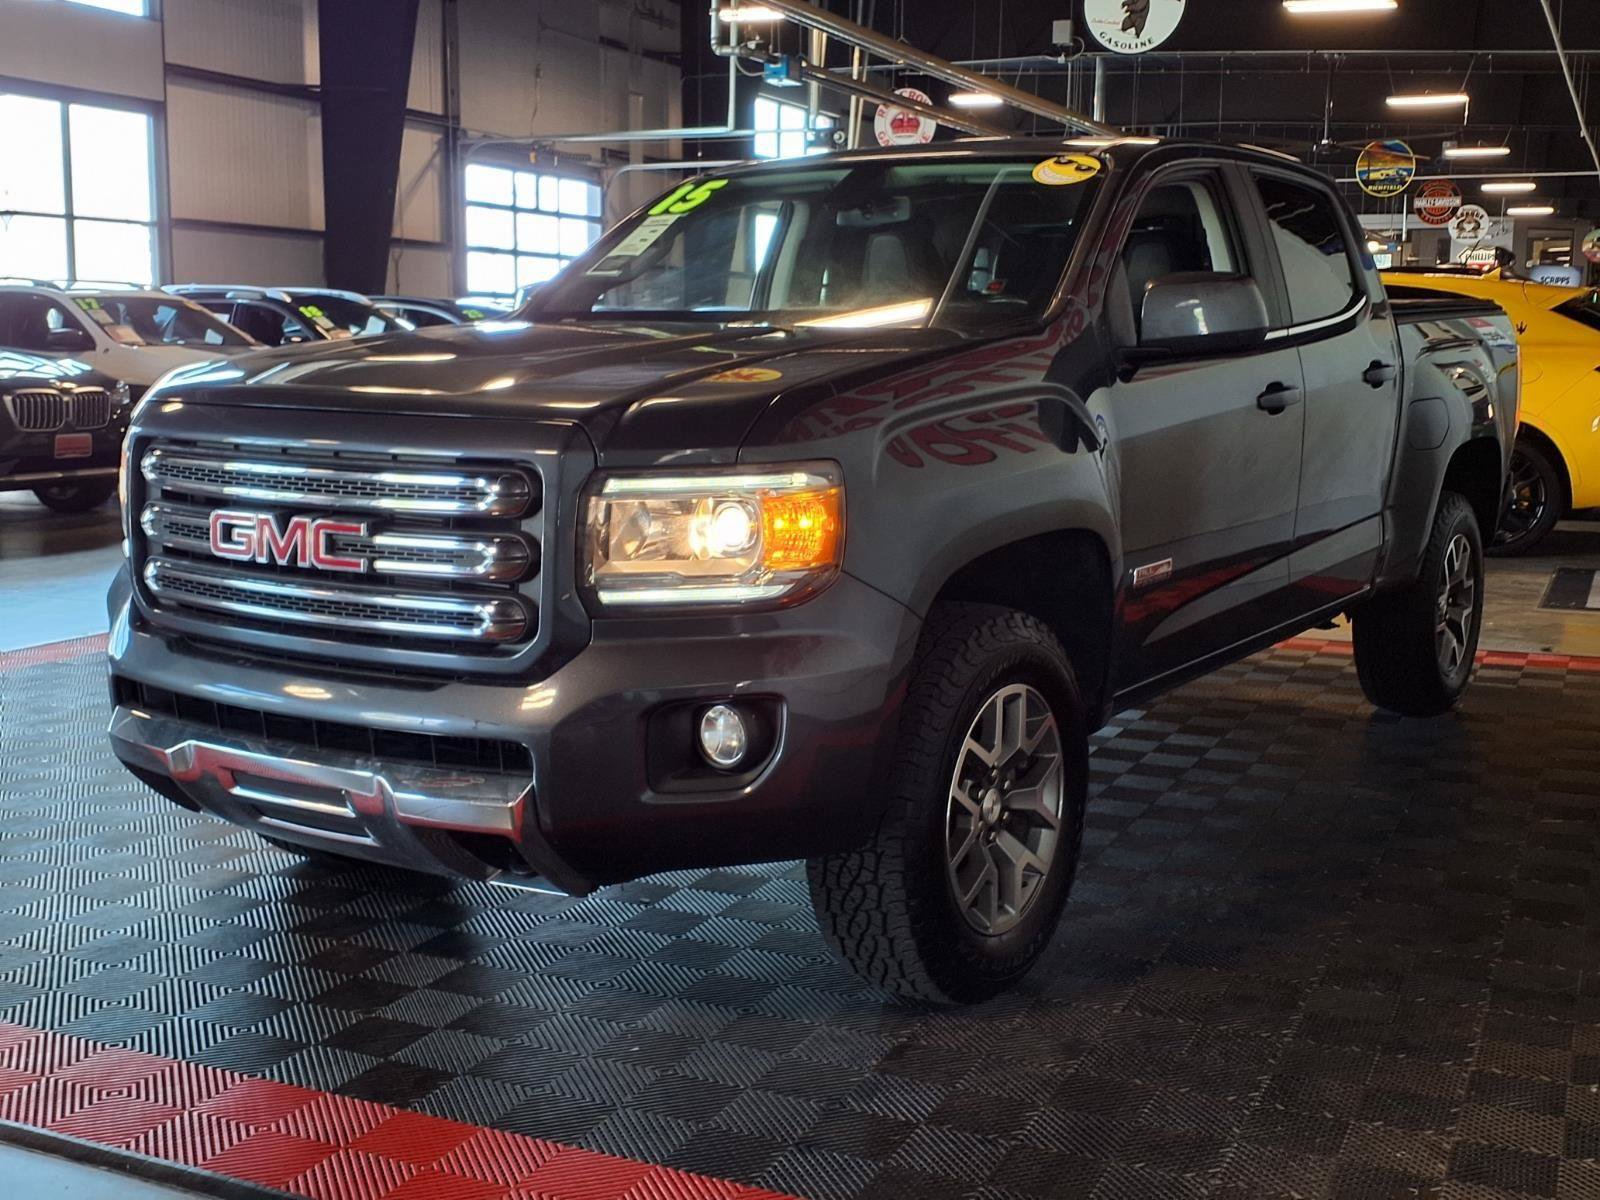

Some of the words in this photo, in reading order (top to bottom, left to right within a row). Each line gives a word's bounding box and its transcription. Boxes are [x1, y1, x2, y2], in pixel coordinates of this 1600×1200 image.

[1099, 31, 1155, 50] GASOLINE
[648, 178, 729, 216] 15
[1540, 275, 1571, 285] SCRIPPS
[209, 509, 368, 574] GMC
